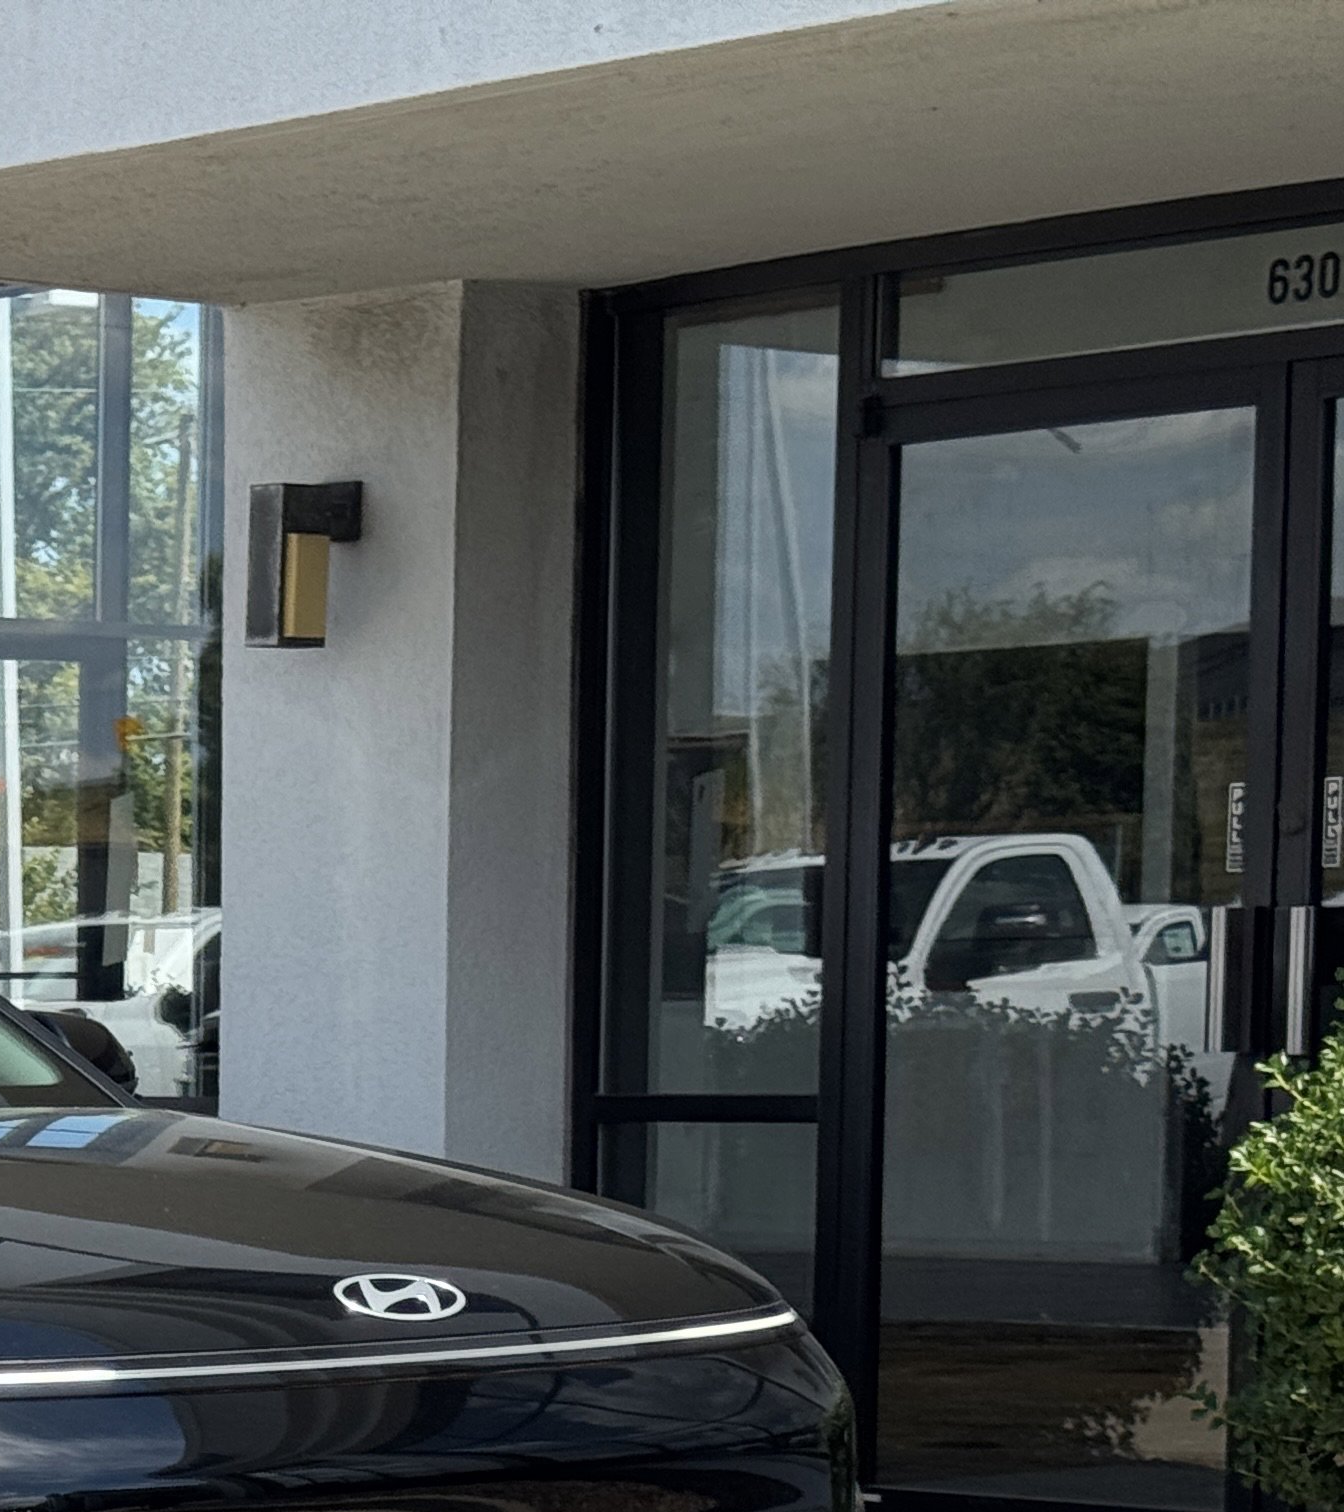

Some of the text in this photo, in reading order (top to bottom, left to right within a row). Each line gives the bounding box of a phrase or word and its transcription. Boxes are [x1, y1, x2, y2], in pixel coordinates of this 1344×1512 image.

[1268, 251, 1341, 304] 630
[1232, 788, 1244, 843] PULL
[1327, 782, 1338, 838] PULL
